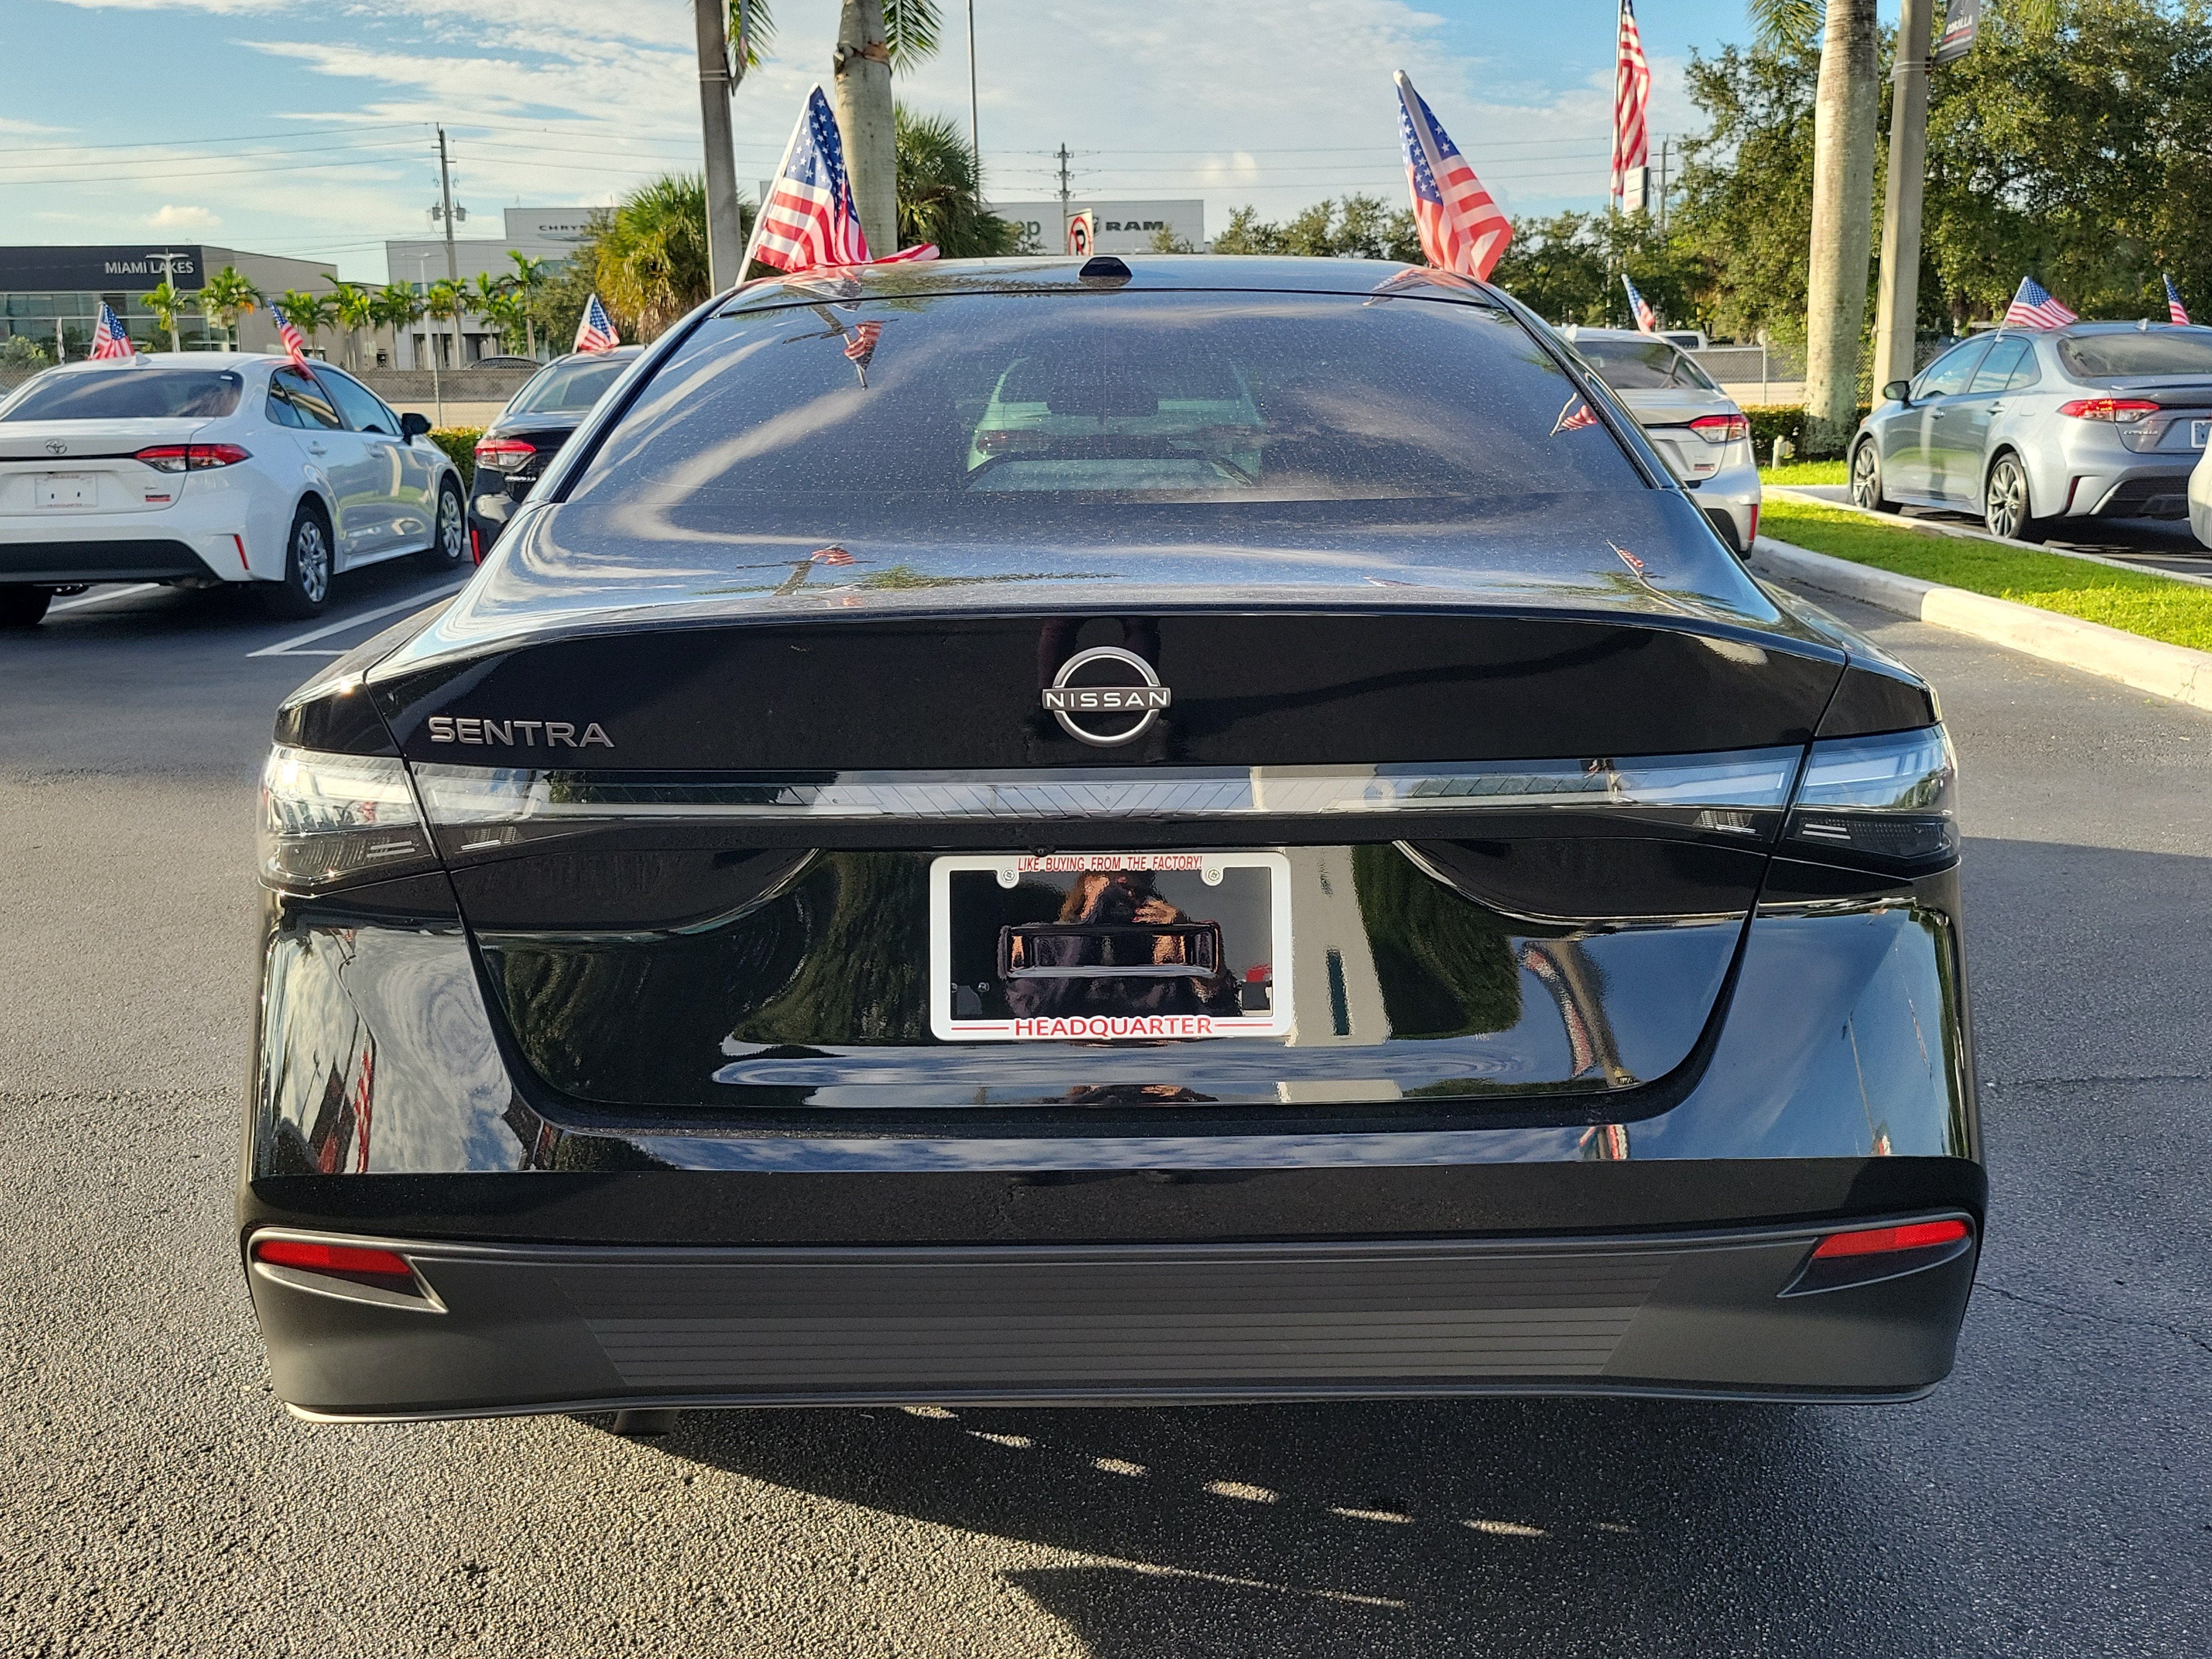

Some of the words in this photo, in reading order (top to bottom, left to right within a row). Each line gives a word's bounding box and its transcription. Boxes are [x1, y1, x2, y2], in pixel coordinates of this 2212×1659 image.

[1106, 221, 1163, 231] RAM
[105, 261, 147, 274] MIAMI
[150, 261, 194, 274] LAKES
[1046, 691, 1167, 708] NISSAN
[428, 716, 616, 748] SENTRA
[1018, 857, 1040, 871] LIKE
[1046, 857, 1085, 871] BUYING
[1091, 856, 1121, 871] FROM
[1127, 856, 1147, 870] THE
[1153, 855, 1203, 870] FACTORY!
[1015, 1017, 1212, 1037] HEADQUARTER
